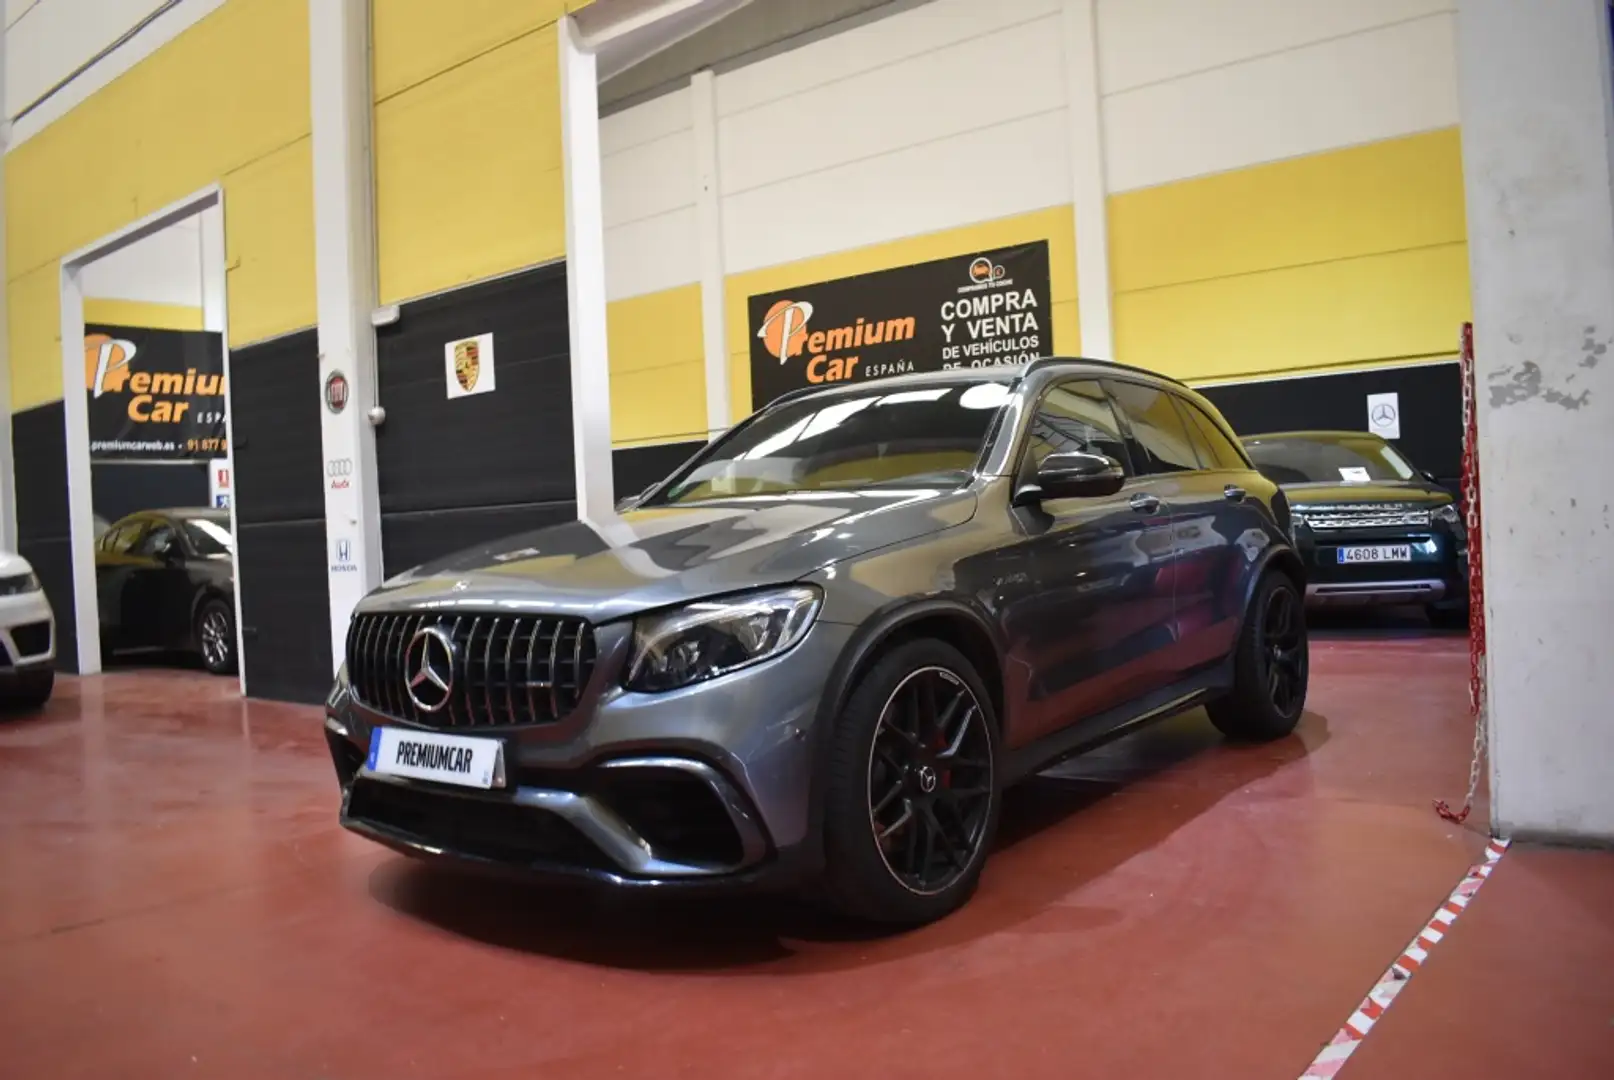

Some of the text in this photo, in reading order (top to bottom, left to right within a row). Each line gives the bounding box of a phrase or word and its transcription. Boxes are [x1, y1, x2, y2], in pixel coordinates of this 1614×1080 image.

[941, 288, 1038, 321] COMPRA
[757, 301, 915, 366] Premium
[941, 312, 1039, 343] Y VENTA
[942, 335, 1040, 359] DE VEHÍCULOS
[806, 354, 915, 384] Car ESPAÑA
[128, 394, 189, 423] Car
[331, 564, 358, 573] HONDA
[1346, 547, 1407, 561] 4608 LMW
[396, 739, 473, 774] PREMIUMCAR
